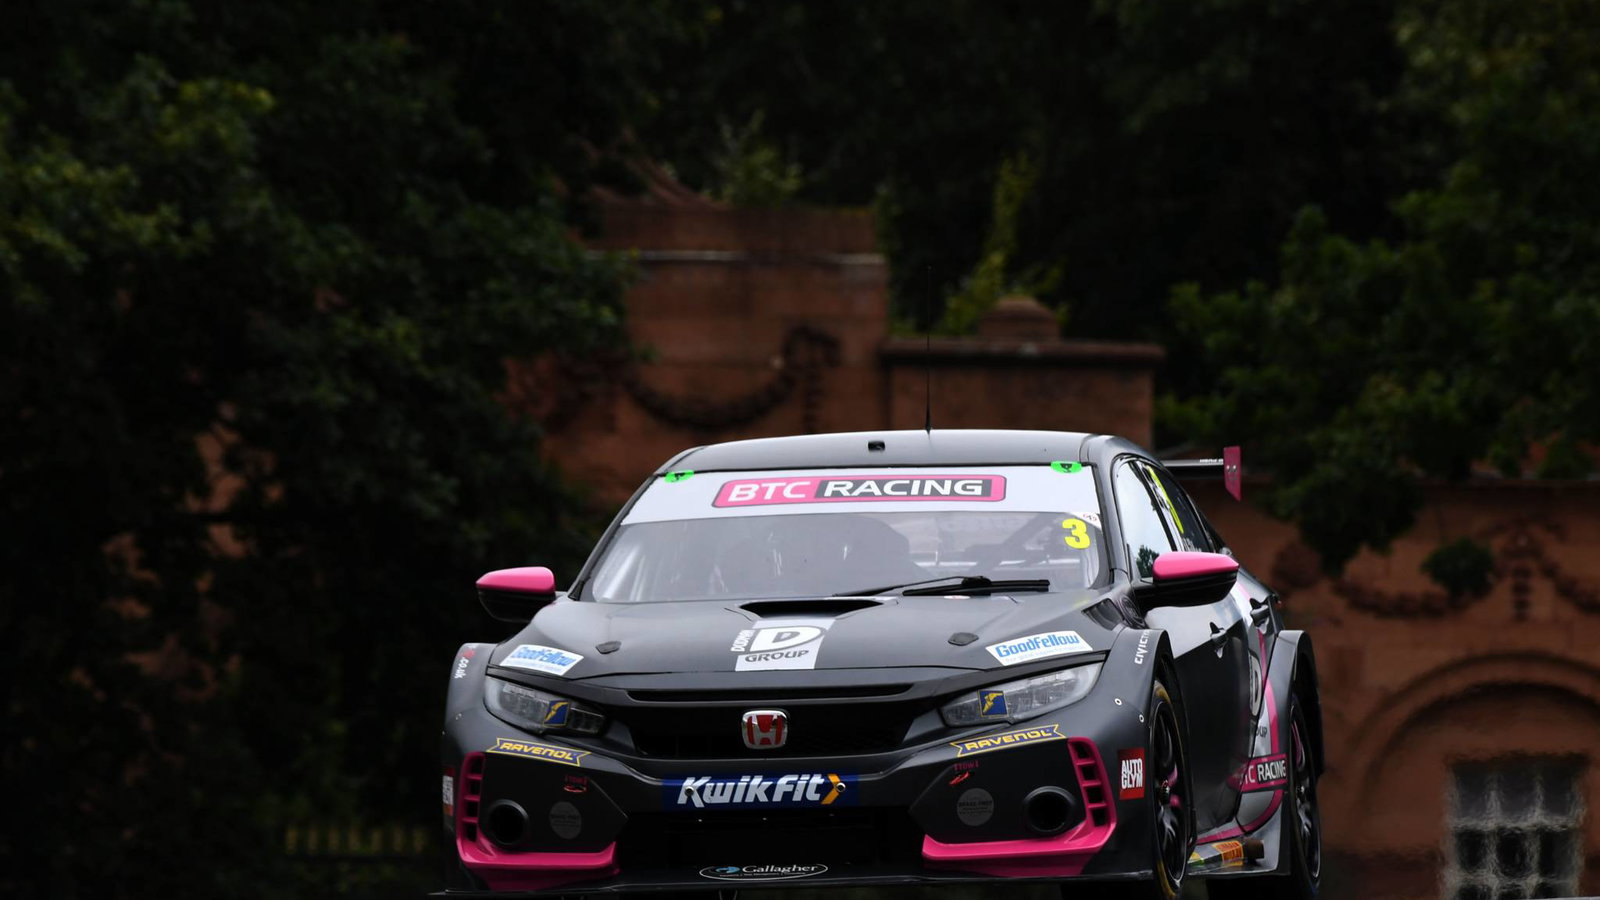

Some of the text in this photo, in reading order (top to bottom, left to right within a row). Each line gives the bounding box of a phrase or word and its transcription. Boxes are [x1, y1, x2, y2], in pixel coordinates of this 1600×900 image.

[727, 479, 984, 501] BTC RACING
[1062, 518, 1090, 549] 3
[745, 650, 809, 663] GROUP
[1134, 638, 1148, 664] CIVIC
[965, 729, 1053, 752] RAVENOL
[499, 742, 575, 761] RAVENOL
[1121, 758, 1144, 775] AUTO
[1257, 760, 1287, 782] RACING
[1121, 772, 1144, 789] GLYM
[742, 864, 818, 874] Gallagher
